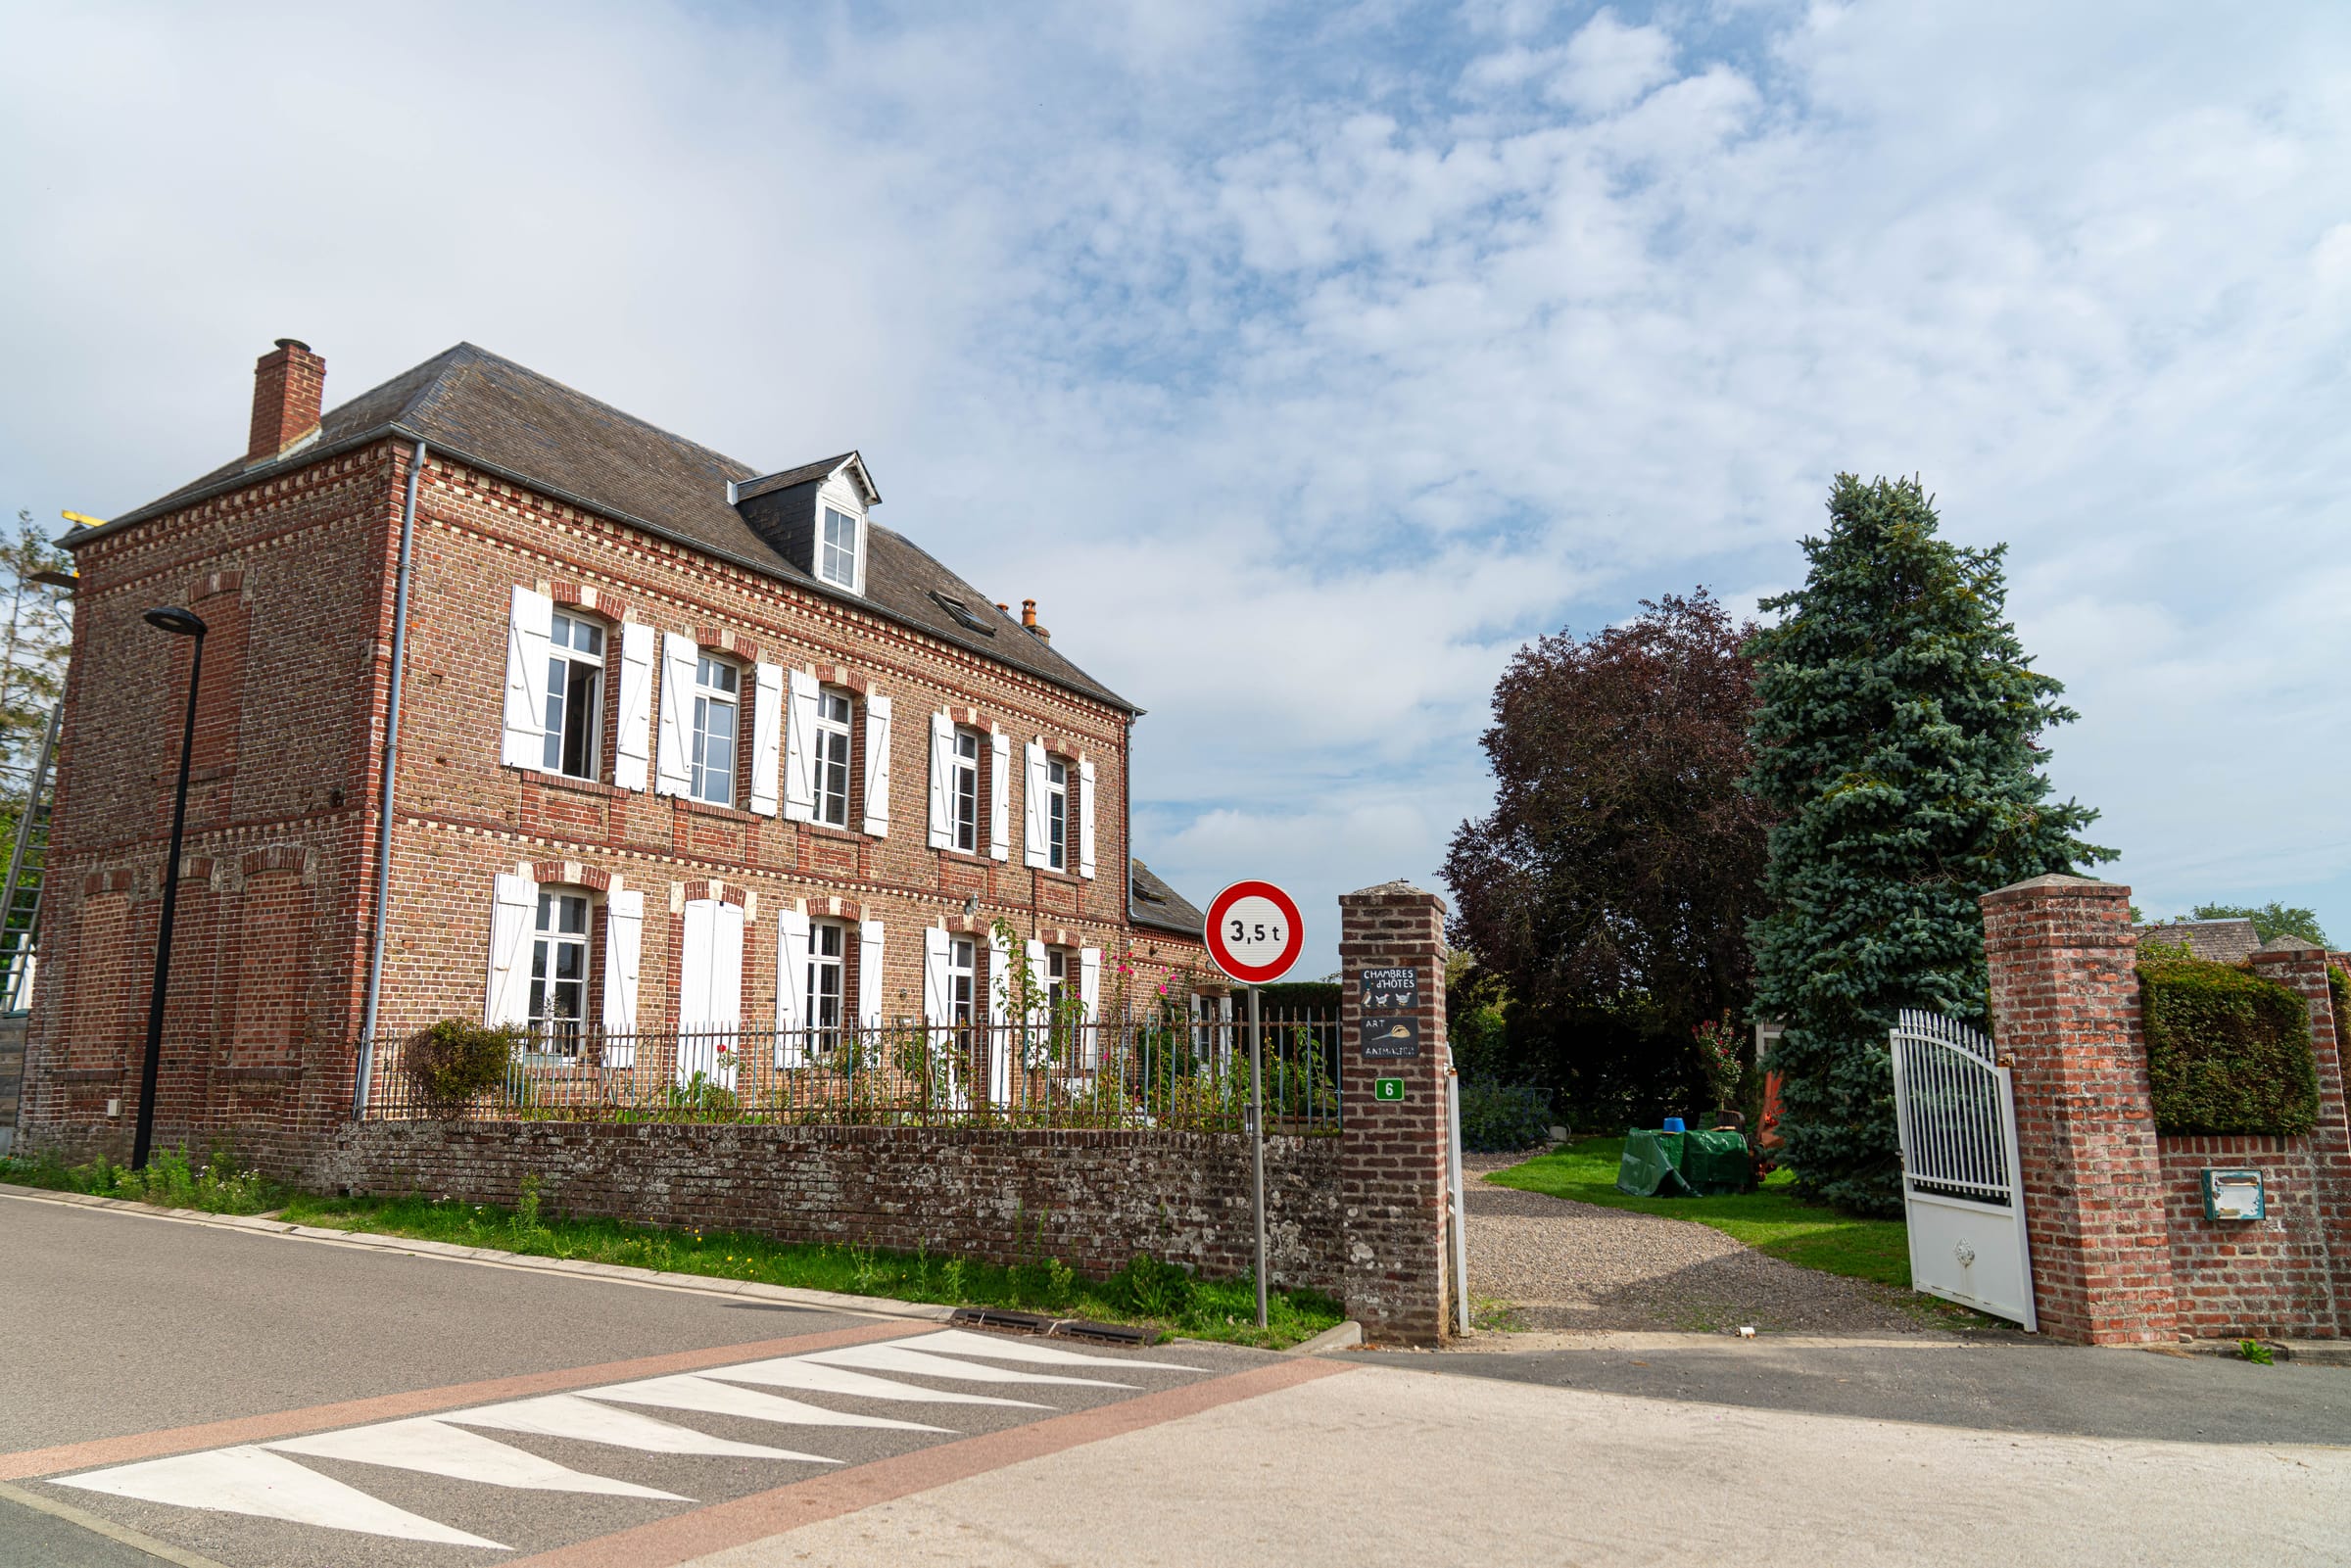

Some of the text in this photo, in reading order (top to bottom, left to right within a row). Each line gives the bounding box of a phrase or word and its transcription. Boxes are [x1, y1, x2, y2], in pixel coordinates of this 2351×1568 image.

[1230, 920, 1280, 945] 3,5 t
[1364, 969, 1414, 979] CHAMBRES
[1376, 977, 1415, 988] d'HÔTES
[1385, 1082, 1394, 1096] 6
